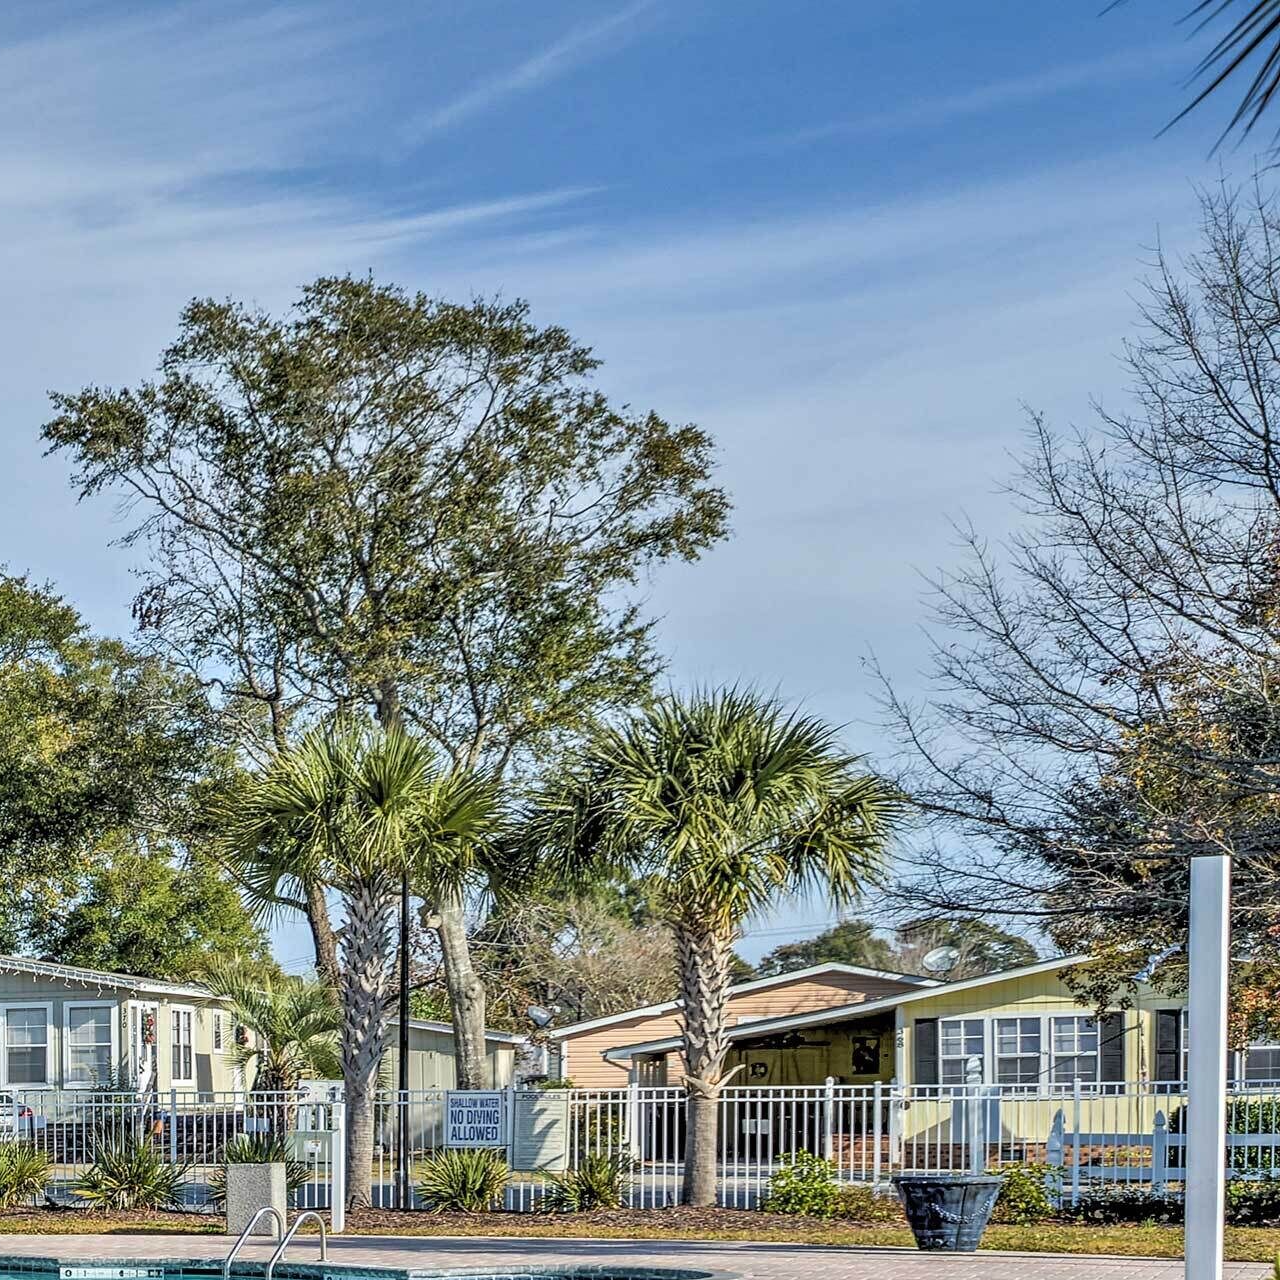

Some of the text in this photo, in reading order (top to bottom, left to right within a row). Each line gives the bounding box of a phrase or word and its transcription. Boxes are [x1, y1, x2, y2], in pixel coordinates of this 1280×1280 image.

[450, 1098, 499, 1108] SHALLOW WATER
[450, 1110, 499, 1124] NO DIVING
[451, 1126, 498, 1140] ALLOWED
